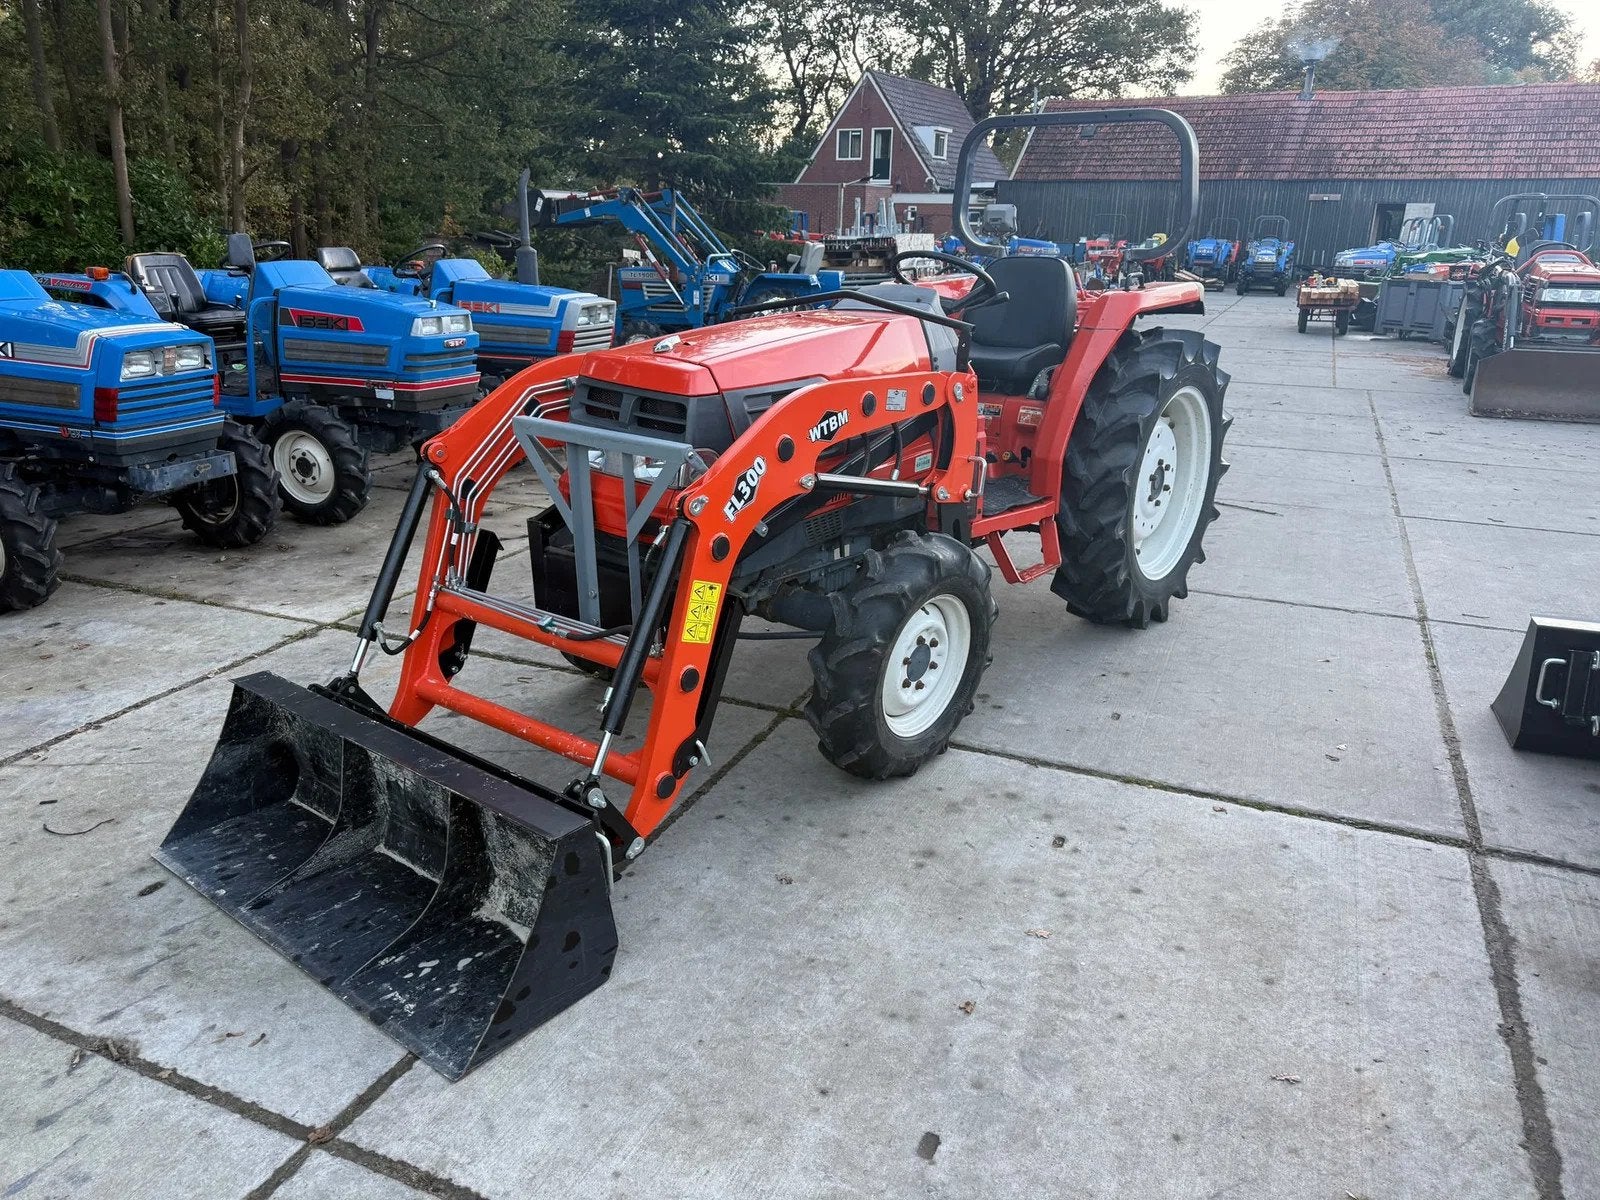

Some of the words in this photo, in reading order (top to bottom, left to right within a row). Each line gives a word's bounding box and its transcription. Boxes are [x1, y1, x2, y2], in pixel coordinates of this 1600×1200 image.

[457, 301, 501, 314] ISEKI
[299, 314, 348, 330] ISEKI
[808, 409, 849, 442] WTBM
[723, 456, 767, 521] FL300
